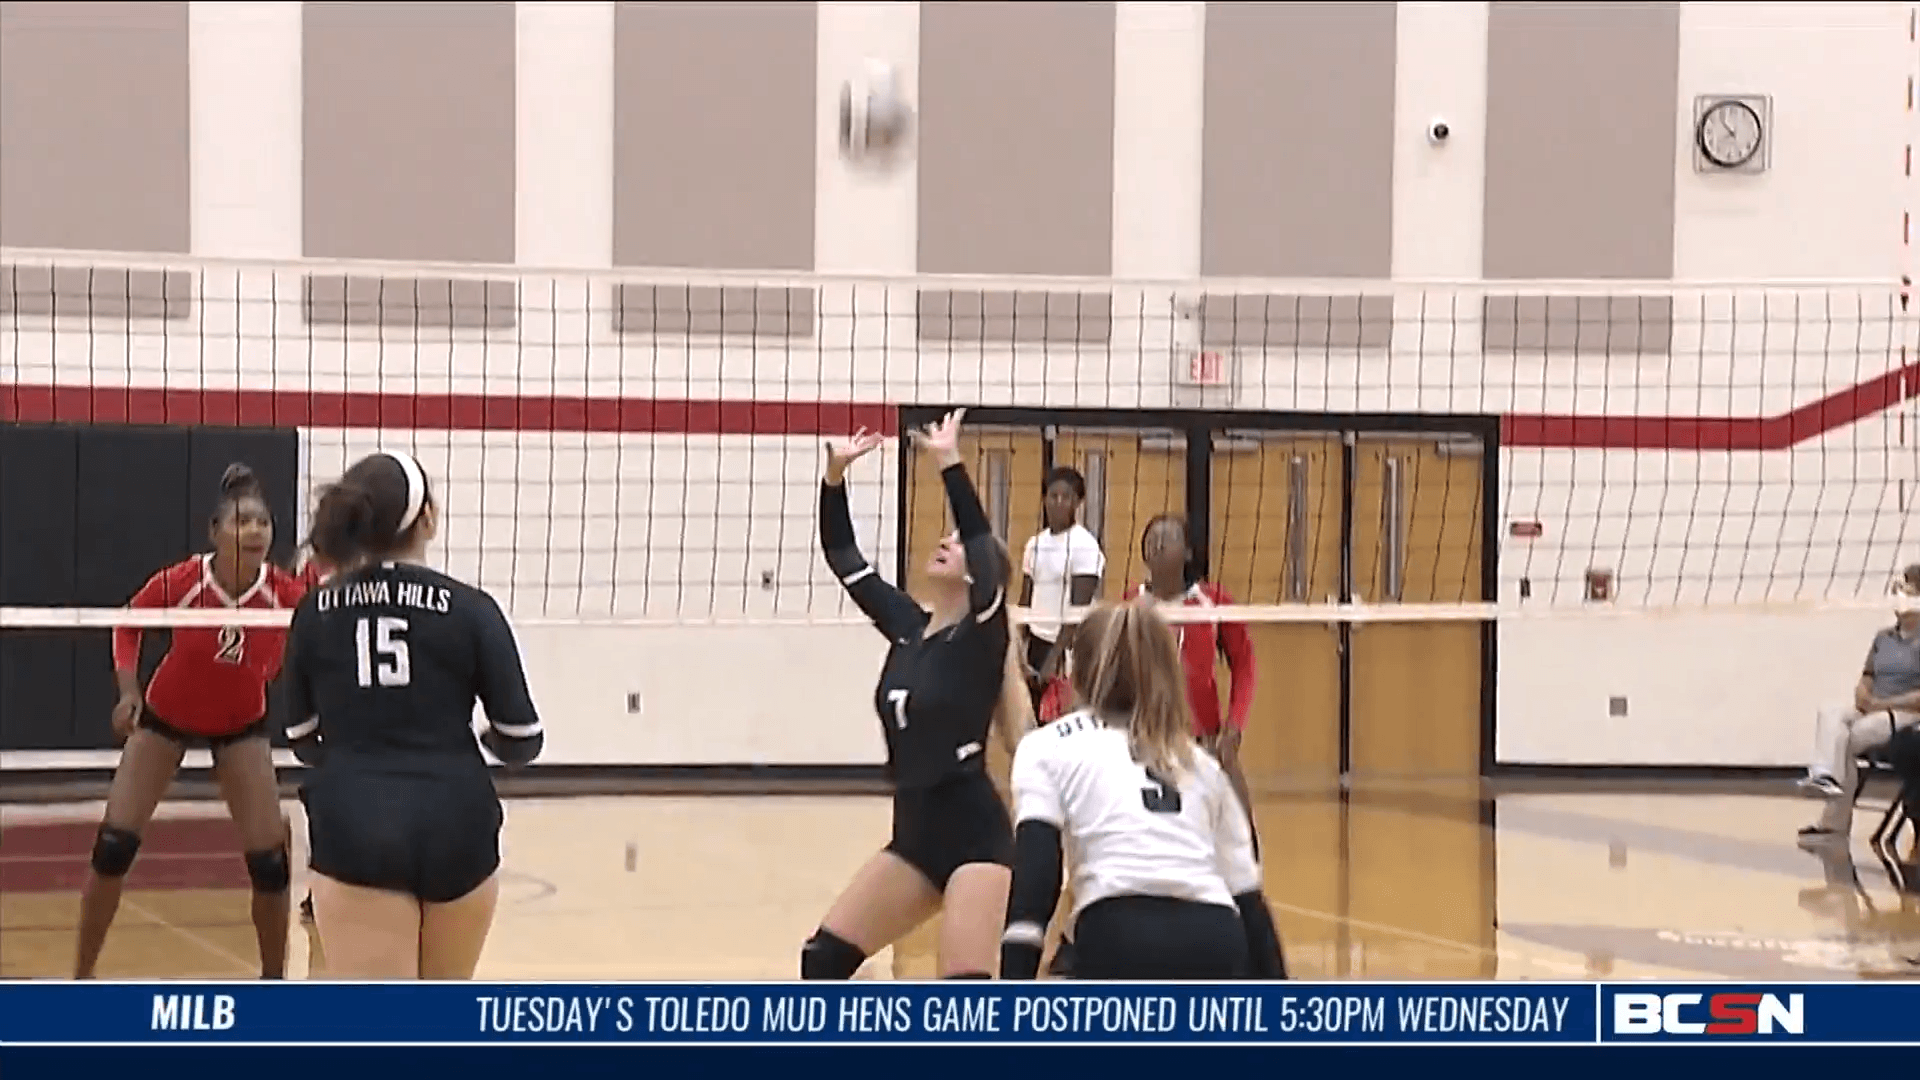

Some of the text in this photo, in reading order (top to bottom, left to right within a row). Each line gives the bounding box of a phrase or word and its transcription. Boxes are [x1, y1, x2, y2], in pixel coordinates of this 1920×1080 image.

[1189, 351, 1225, 384] EXIT
[317, 580, 451, 613] OTTAWA HILLS
[213, 624, 245, 664] 2
[355, 616, 411, 687] 15
[887, 688, 910, 730] 7
